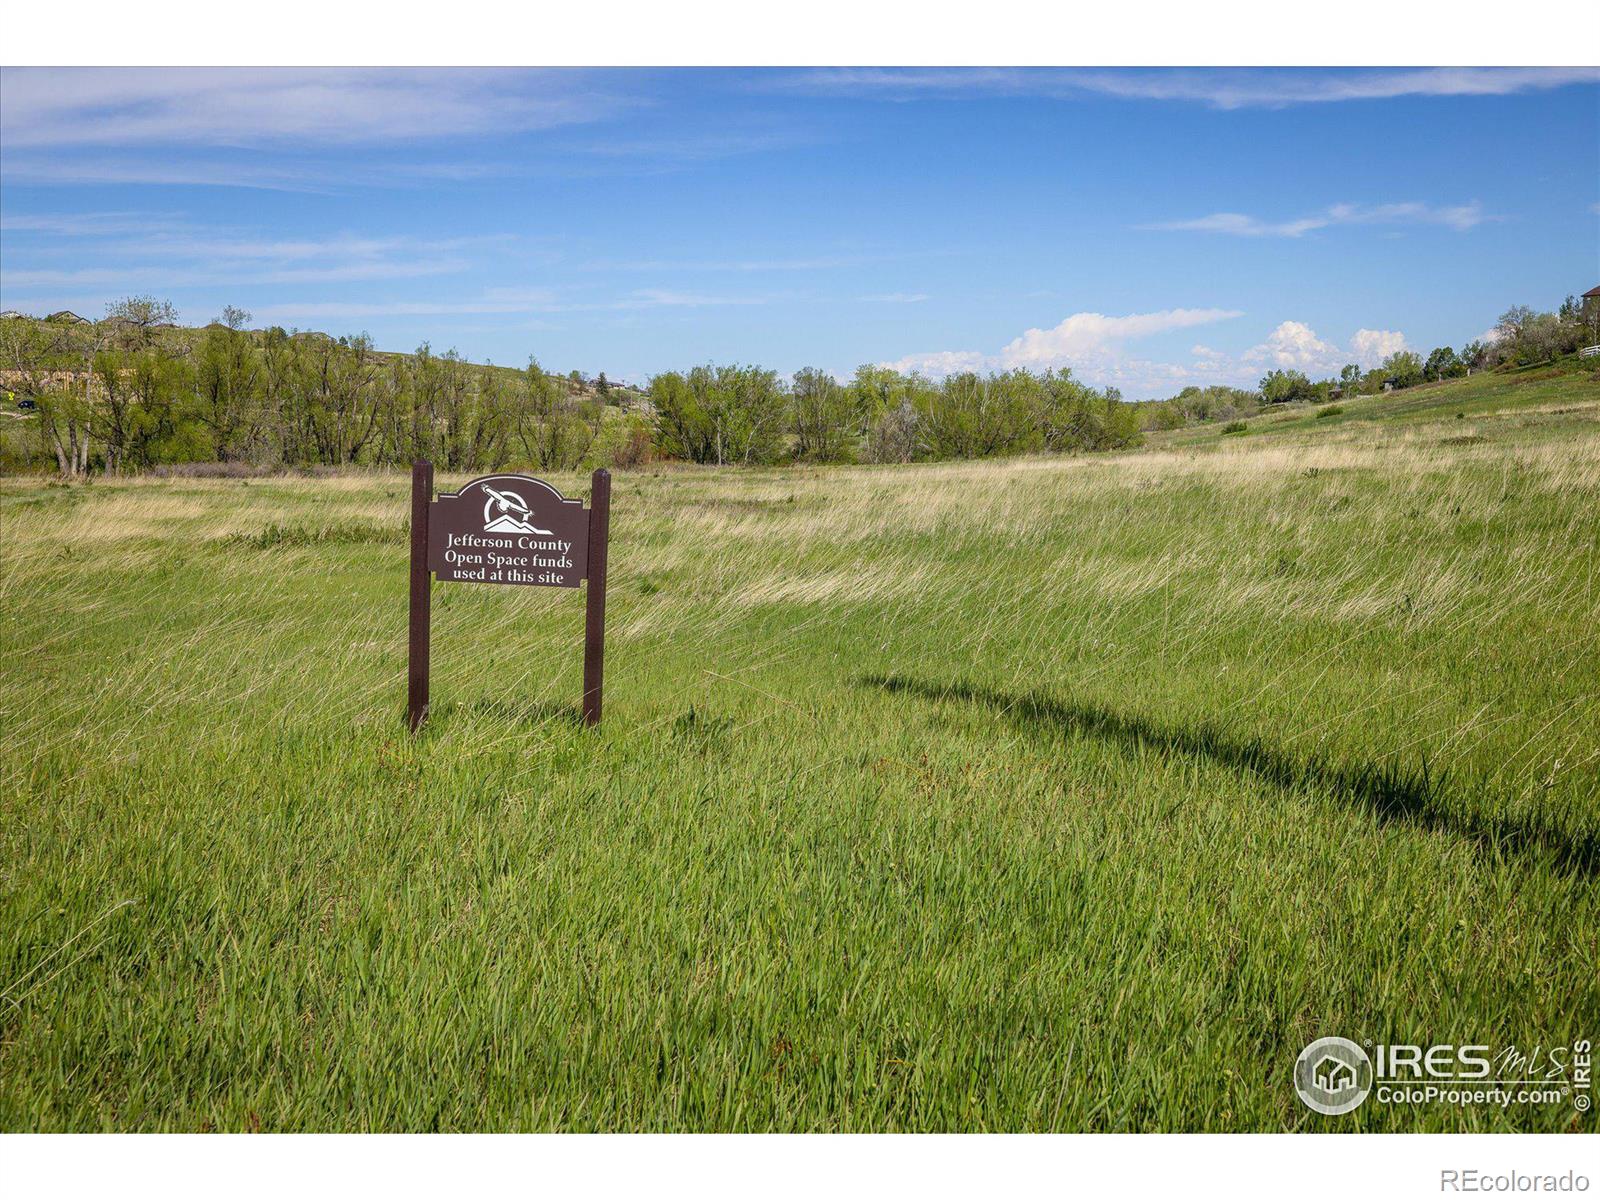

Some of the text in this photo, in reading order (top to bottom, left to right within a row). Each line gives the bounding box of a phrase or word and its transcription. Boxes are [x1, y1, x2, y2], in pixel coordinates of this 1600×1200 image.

[446, 533, 572, 555] Jefferson County
[445, 550, 573, 569] Open Space funds
[453, 568, 564, 584] used at this site
